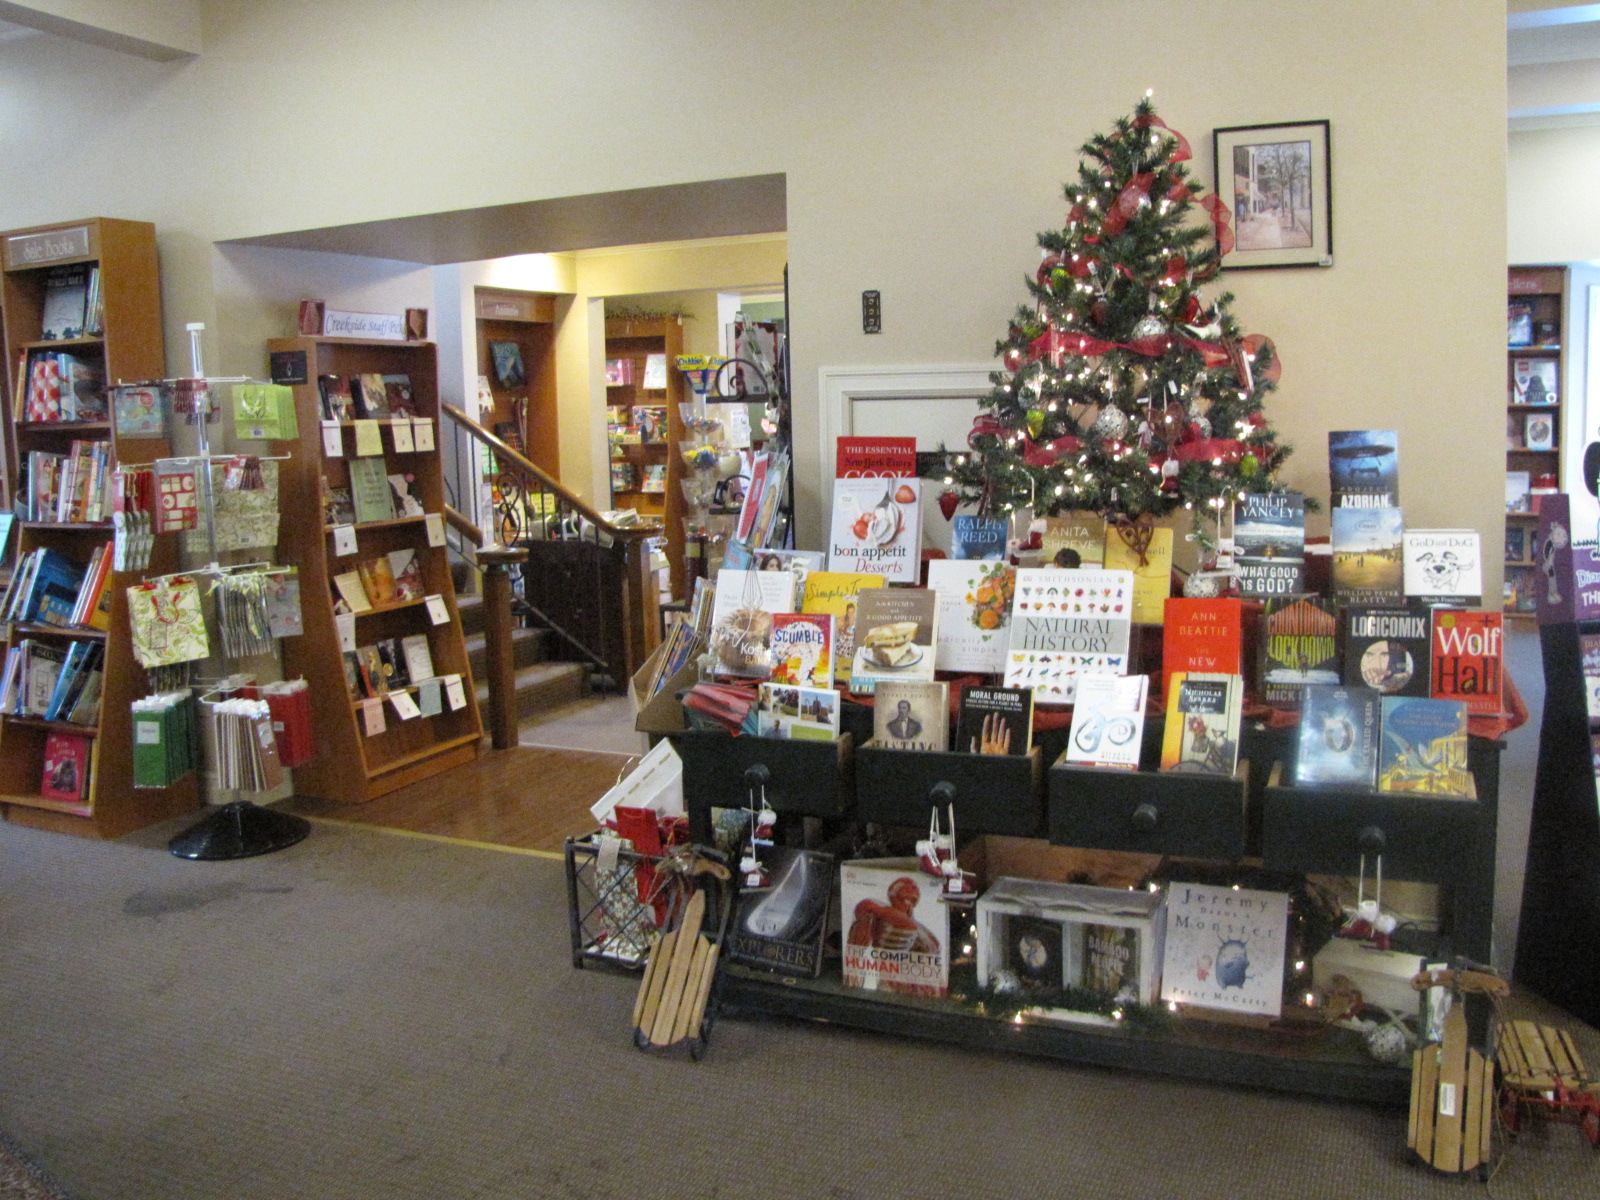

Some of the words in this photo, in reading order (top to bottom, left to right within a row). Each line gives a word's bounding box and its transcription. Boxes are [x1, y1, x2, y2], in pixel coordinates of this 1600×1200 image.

[326, 314, 366, 333] Creekside
[845, 446, 863, 454] THE
[865, 446, 913, 455] ESSENTIAL
[844, 458, 862, 468] New
[863, 458, 885, 470] York
[886, 458, 912, 468] Times
[1249, 496, 1288, 507] PHILIP
[1341, 494, 1389, 508] AZORIAN
[1241, 506, 1294, 518] YANCEY
[960, 531, 998, 543] REED
[1050, 527, 1090, 537] ANITA
[834, 544, 858, 557] bon
[1044, 540, 1096, 550] SHREVE
[855, 558, 903, 574] Desserts
[1240, 565, 1269, 578] WHAT
[1269, 567, 1298, 579] GOOD
[1038, 575, 1112, 583] SMITHSONIAN
[1242, 579, 1253, 591] IS
[1256, 578, 1294, 593] GOD?
[1191, 612, 1217, 621] ANN
[1025, 617, 1114, 634] NATURAL
[1179, 626, 1228, 636] BEATTIE
[1352, 615, 1426, 639] LOGICOMIX
[774, 628, 824, 645] SCUMBLE
[1023, 634, 1114, 652] HISTORY
[1436, 626, 1501, 657] Wolf
[1267, 634, 1336, 670] LOCKDOWN
[1188, 657, 1217, 667] NEW
[1437, 656, 1499, 695] Hall
[970, 690, 992, 700] MORAL
[993, 692, 1020, 702] GROUND
[1185, 688, 1222, 697] NICHOLAS
[1265, 689, 1296, 701] MICK
[1182, 889, 1268, 912] Jeremy
[1175, 914, 1274, 938] Monster
[847, 946, 865, 958] THE
[871, 951, 942, 967] COMPLETE
[1172, 986, 1206, 998] Peter
